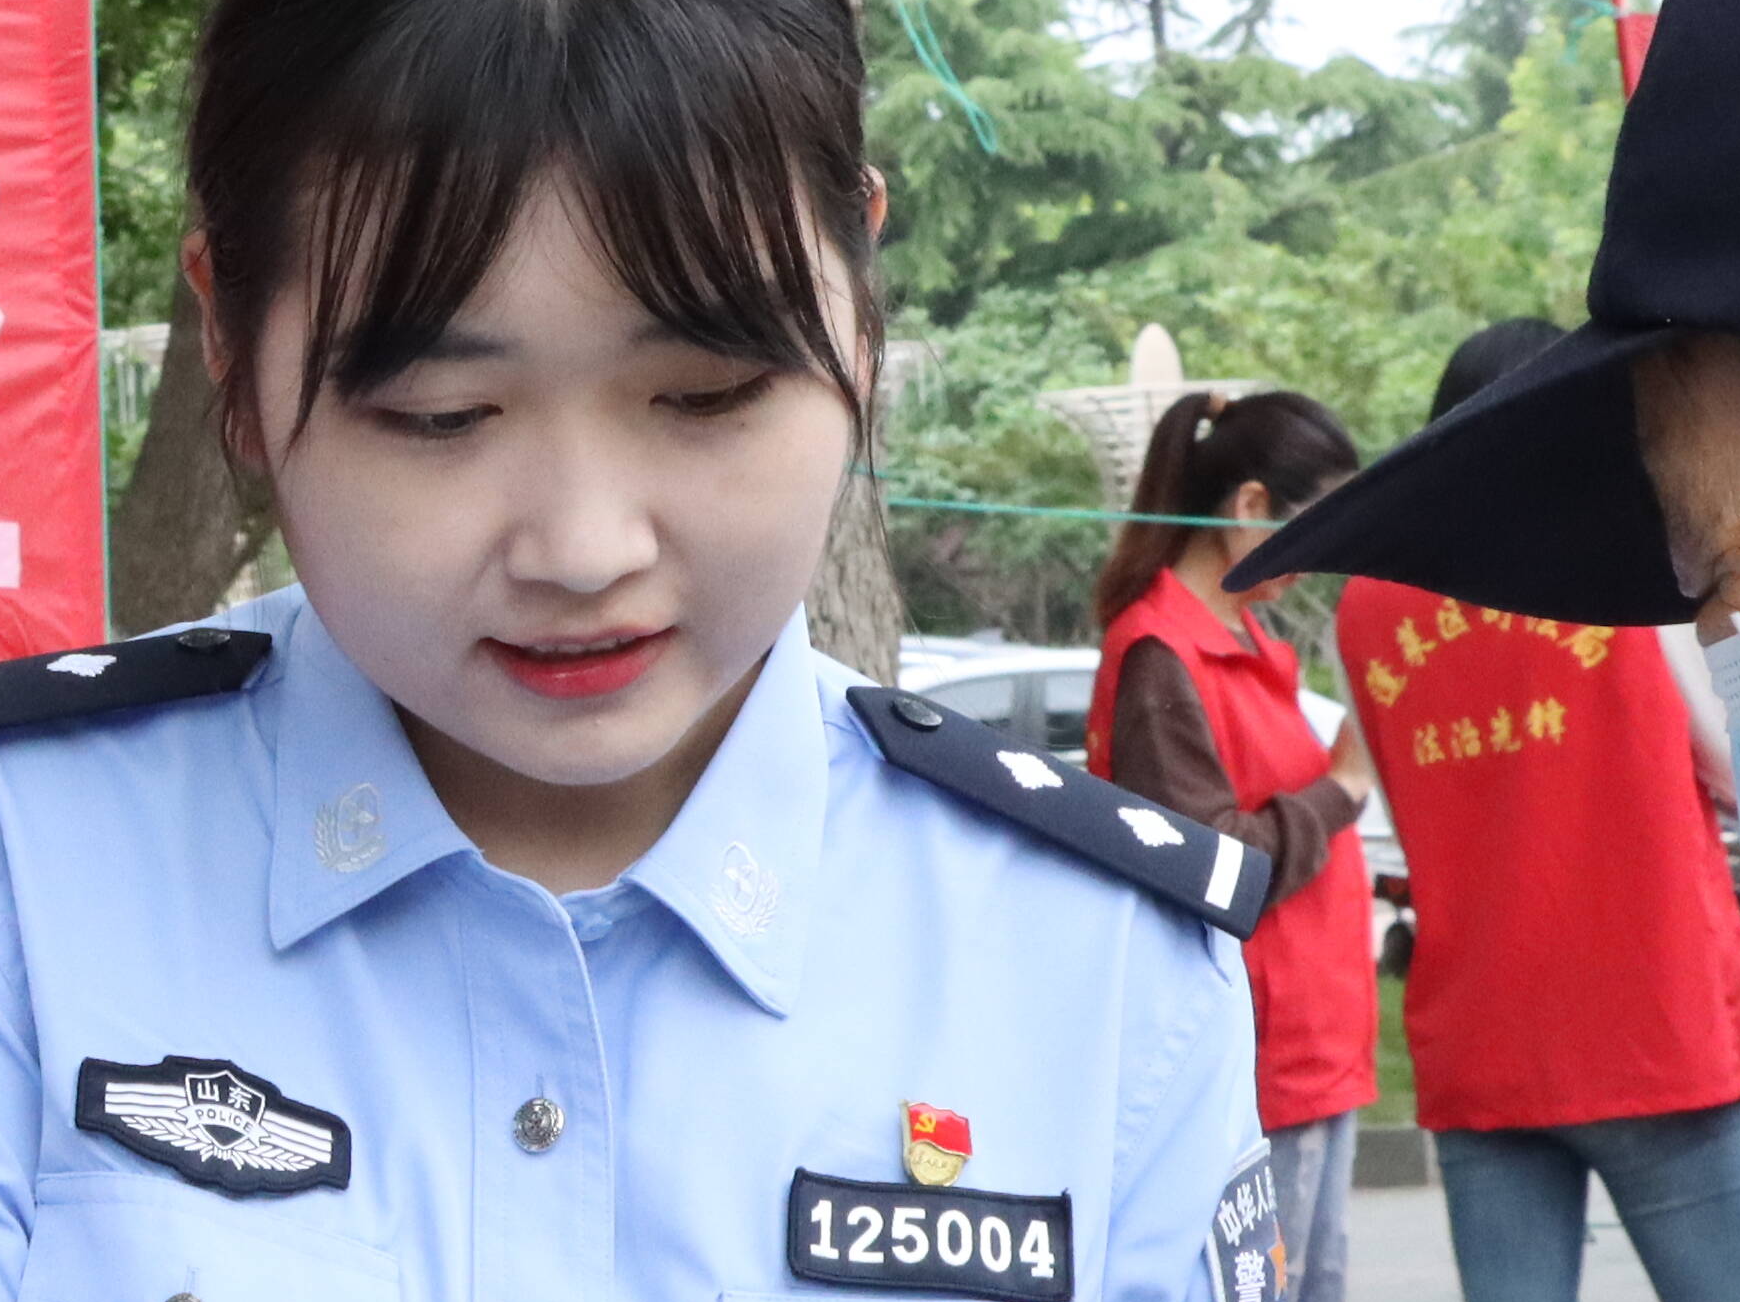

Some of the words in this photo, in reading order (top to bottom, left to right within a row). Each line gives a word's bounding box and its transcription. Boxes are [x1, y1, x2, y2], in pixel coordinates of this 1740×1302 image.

[197, 1079, 253, 1112] 山东
[195, 1107, 254, 1134] POLICE
[809, 1199, 1054, 1279] 125004
